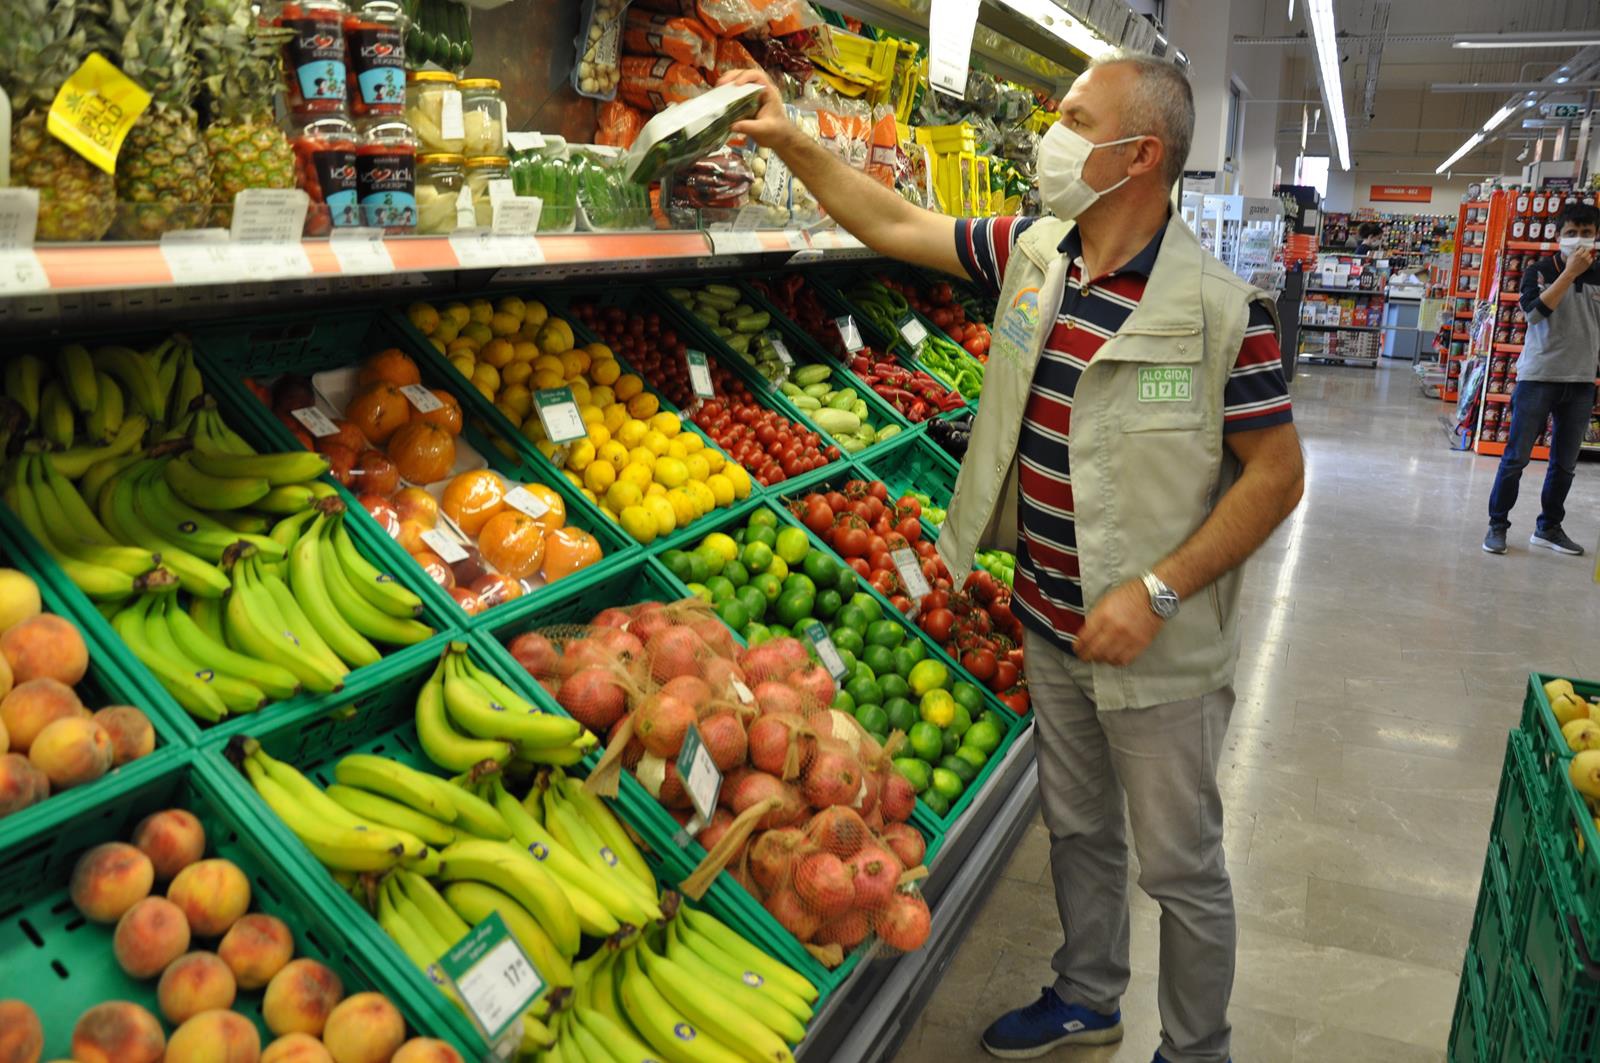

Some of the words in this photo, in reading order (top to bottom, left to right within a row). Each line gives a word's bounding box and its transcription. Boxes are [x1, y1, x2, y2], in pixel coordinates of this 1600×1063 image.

[93, 104, 122, 147] GOLD
[1142, 370, 1161, 381] ALO
[1164, 369, 1189, 381] GIDA
